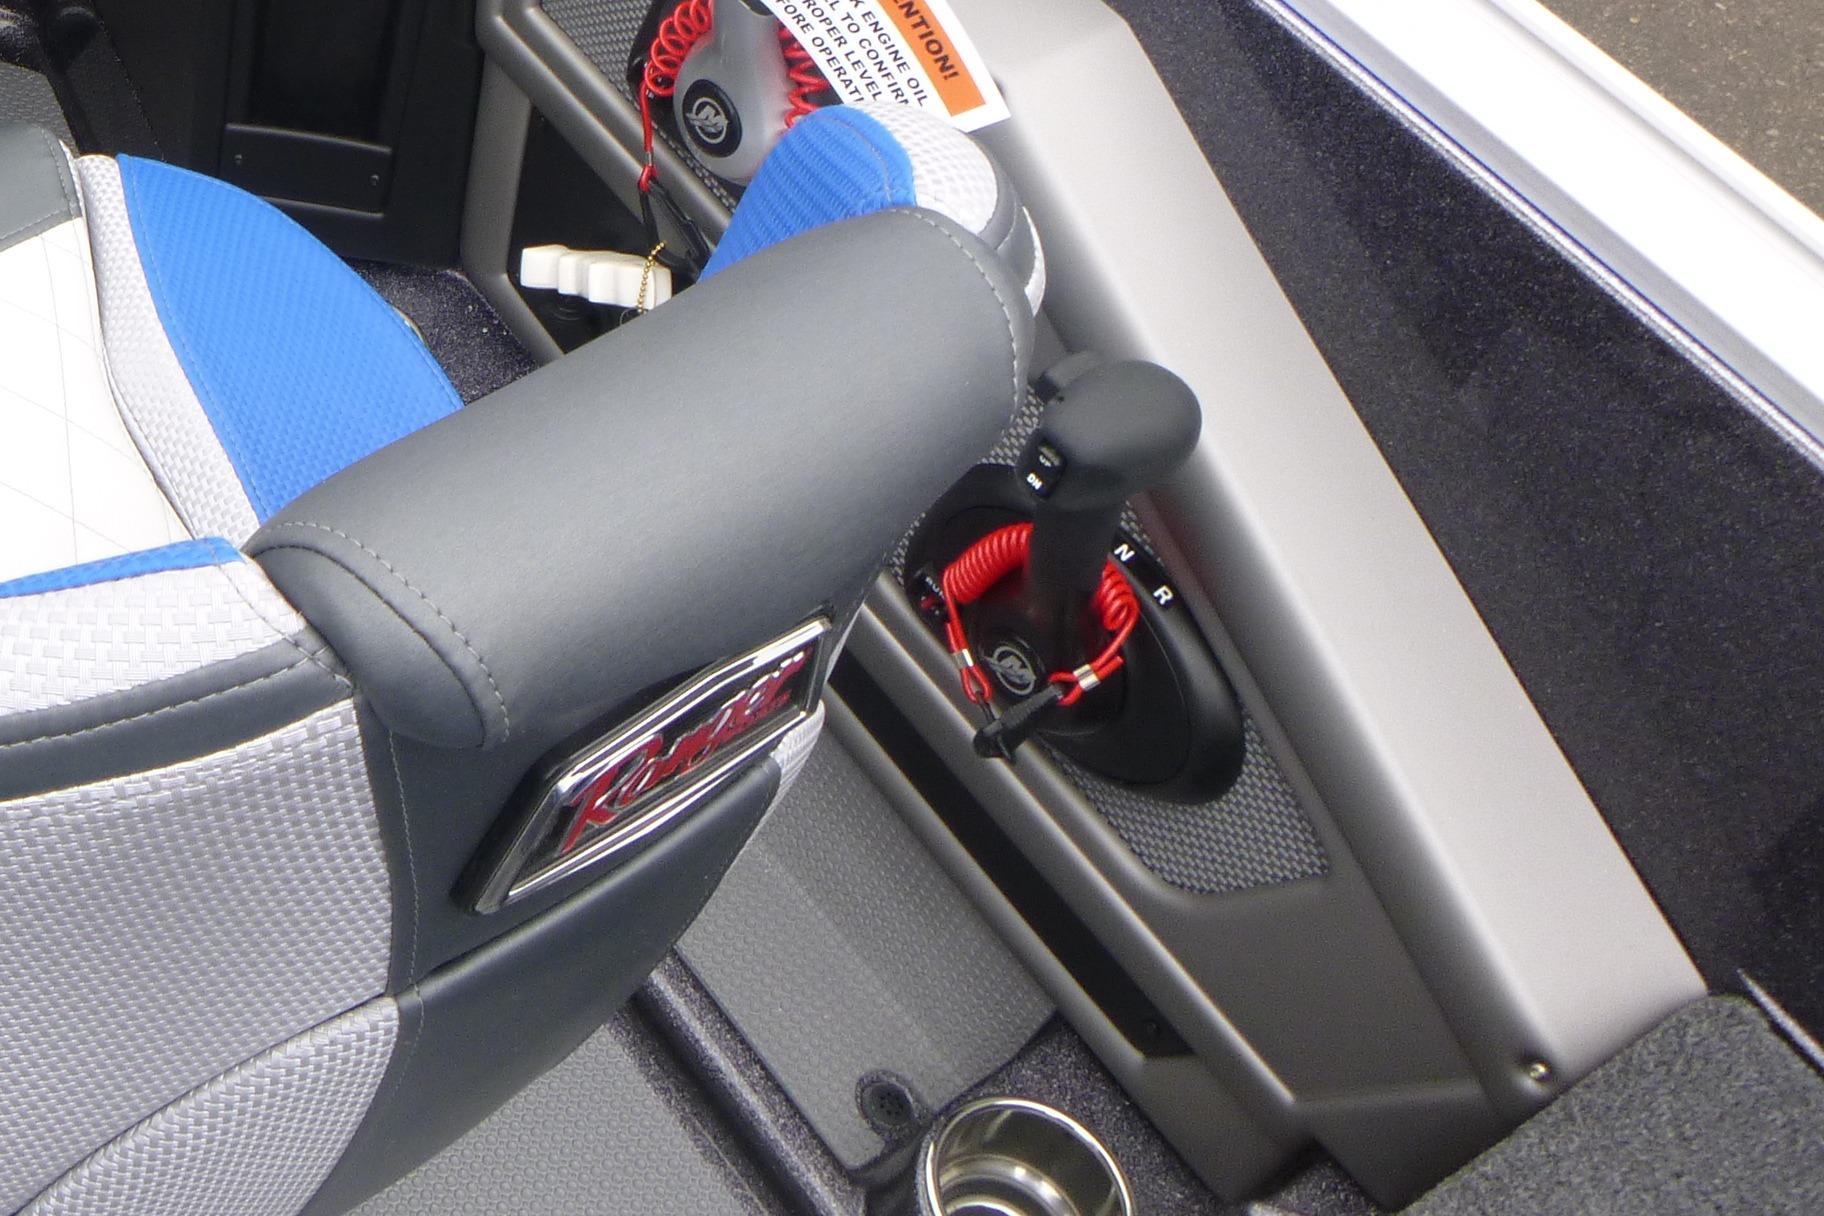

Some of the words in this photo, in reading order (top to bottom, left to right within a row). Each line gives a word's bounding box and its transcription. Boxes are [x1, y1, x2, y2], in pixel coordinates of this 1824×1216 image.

[841, 12, 860, 34] TO
[811, 36, 865, 103] OPERATI
[844, 50, 883, 102] LEVEL
[861, 10, 911, 74] ENGINE
[907, 76, 929, 107] OIL
[1114, 543, 1135, 562] N
[1153, 585, 1174, 605] R
